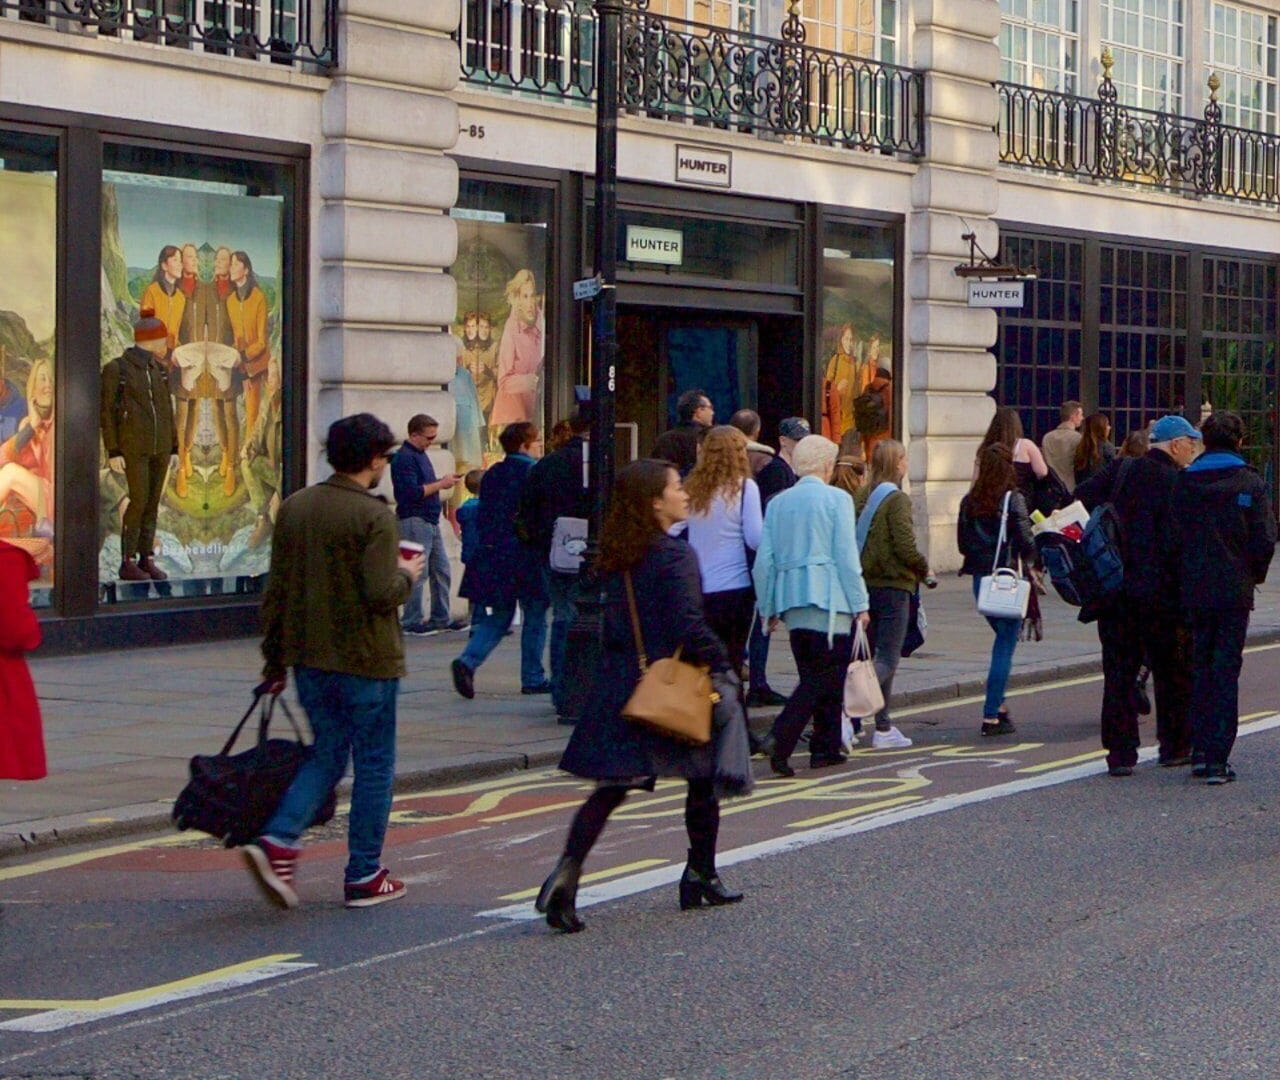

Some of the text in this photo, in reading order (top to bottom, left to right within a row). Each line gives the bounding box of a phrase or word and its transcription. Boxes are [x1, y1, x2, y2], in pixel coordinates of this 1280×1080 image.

[679, 157, 728, 175] HUNTER
[630, 237, 679, 253] HUNTER
[972, 290, 1020, 299] HUNTER
